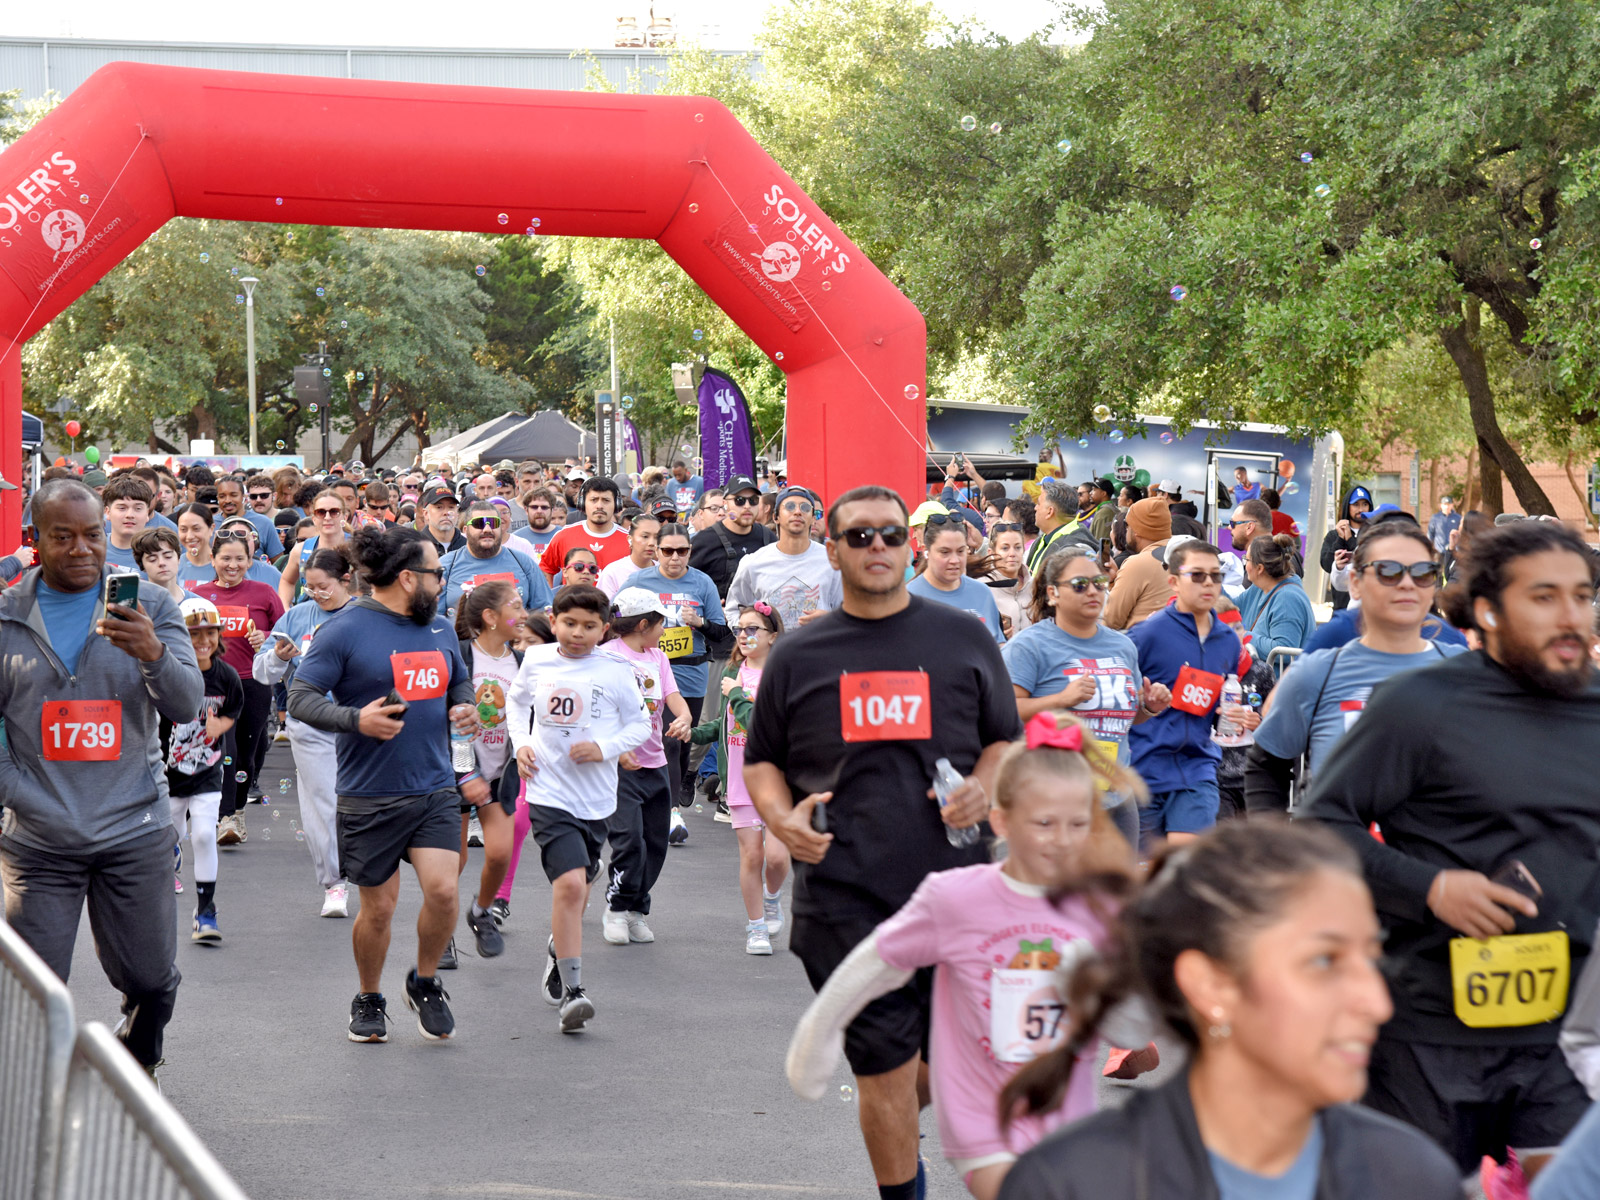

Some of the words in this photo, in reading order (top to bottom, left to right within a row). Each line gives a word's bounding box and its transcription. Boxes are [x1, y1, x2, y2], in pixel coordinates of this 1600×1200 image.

[0, 151, 77, 229] OLER'S
[1, 176, 80, 247] SPORTS
[762, 206, 831, 275] SPORTS
[764, 185, 850, 273] SOLER'S
[38, 216, 121, 291] www.solerssports.com
[722, 240, 797, 315] www.solerssports.com
[603, 419, 612, 479] EMERGENC
[220, 617, 246, 631] 757
[658, 637, 689, 652] 6557
[403, 668, 439, 691] 746
[1181, 683, 1213, 708] 965
[550, 697, 574, 716] 20
[849, 695, 922, 727] 1047
[49, 722, 115, 748] 1739
[482, 735, 504, 744] RUN
[728, 737, 746, 746] IRLS
[1466, 967, 1557, 1007] 6707
[1025, 1004, 1066, 1041] 57
